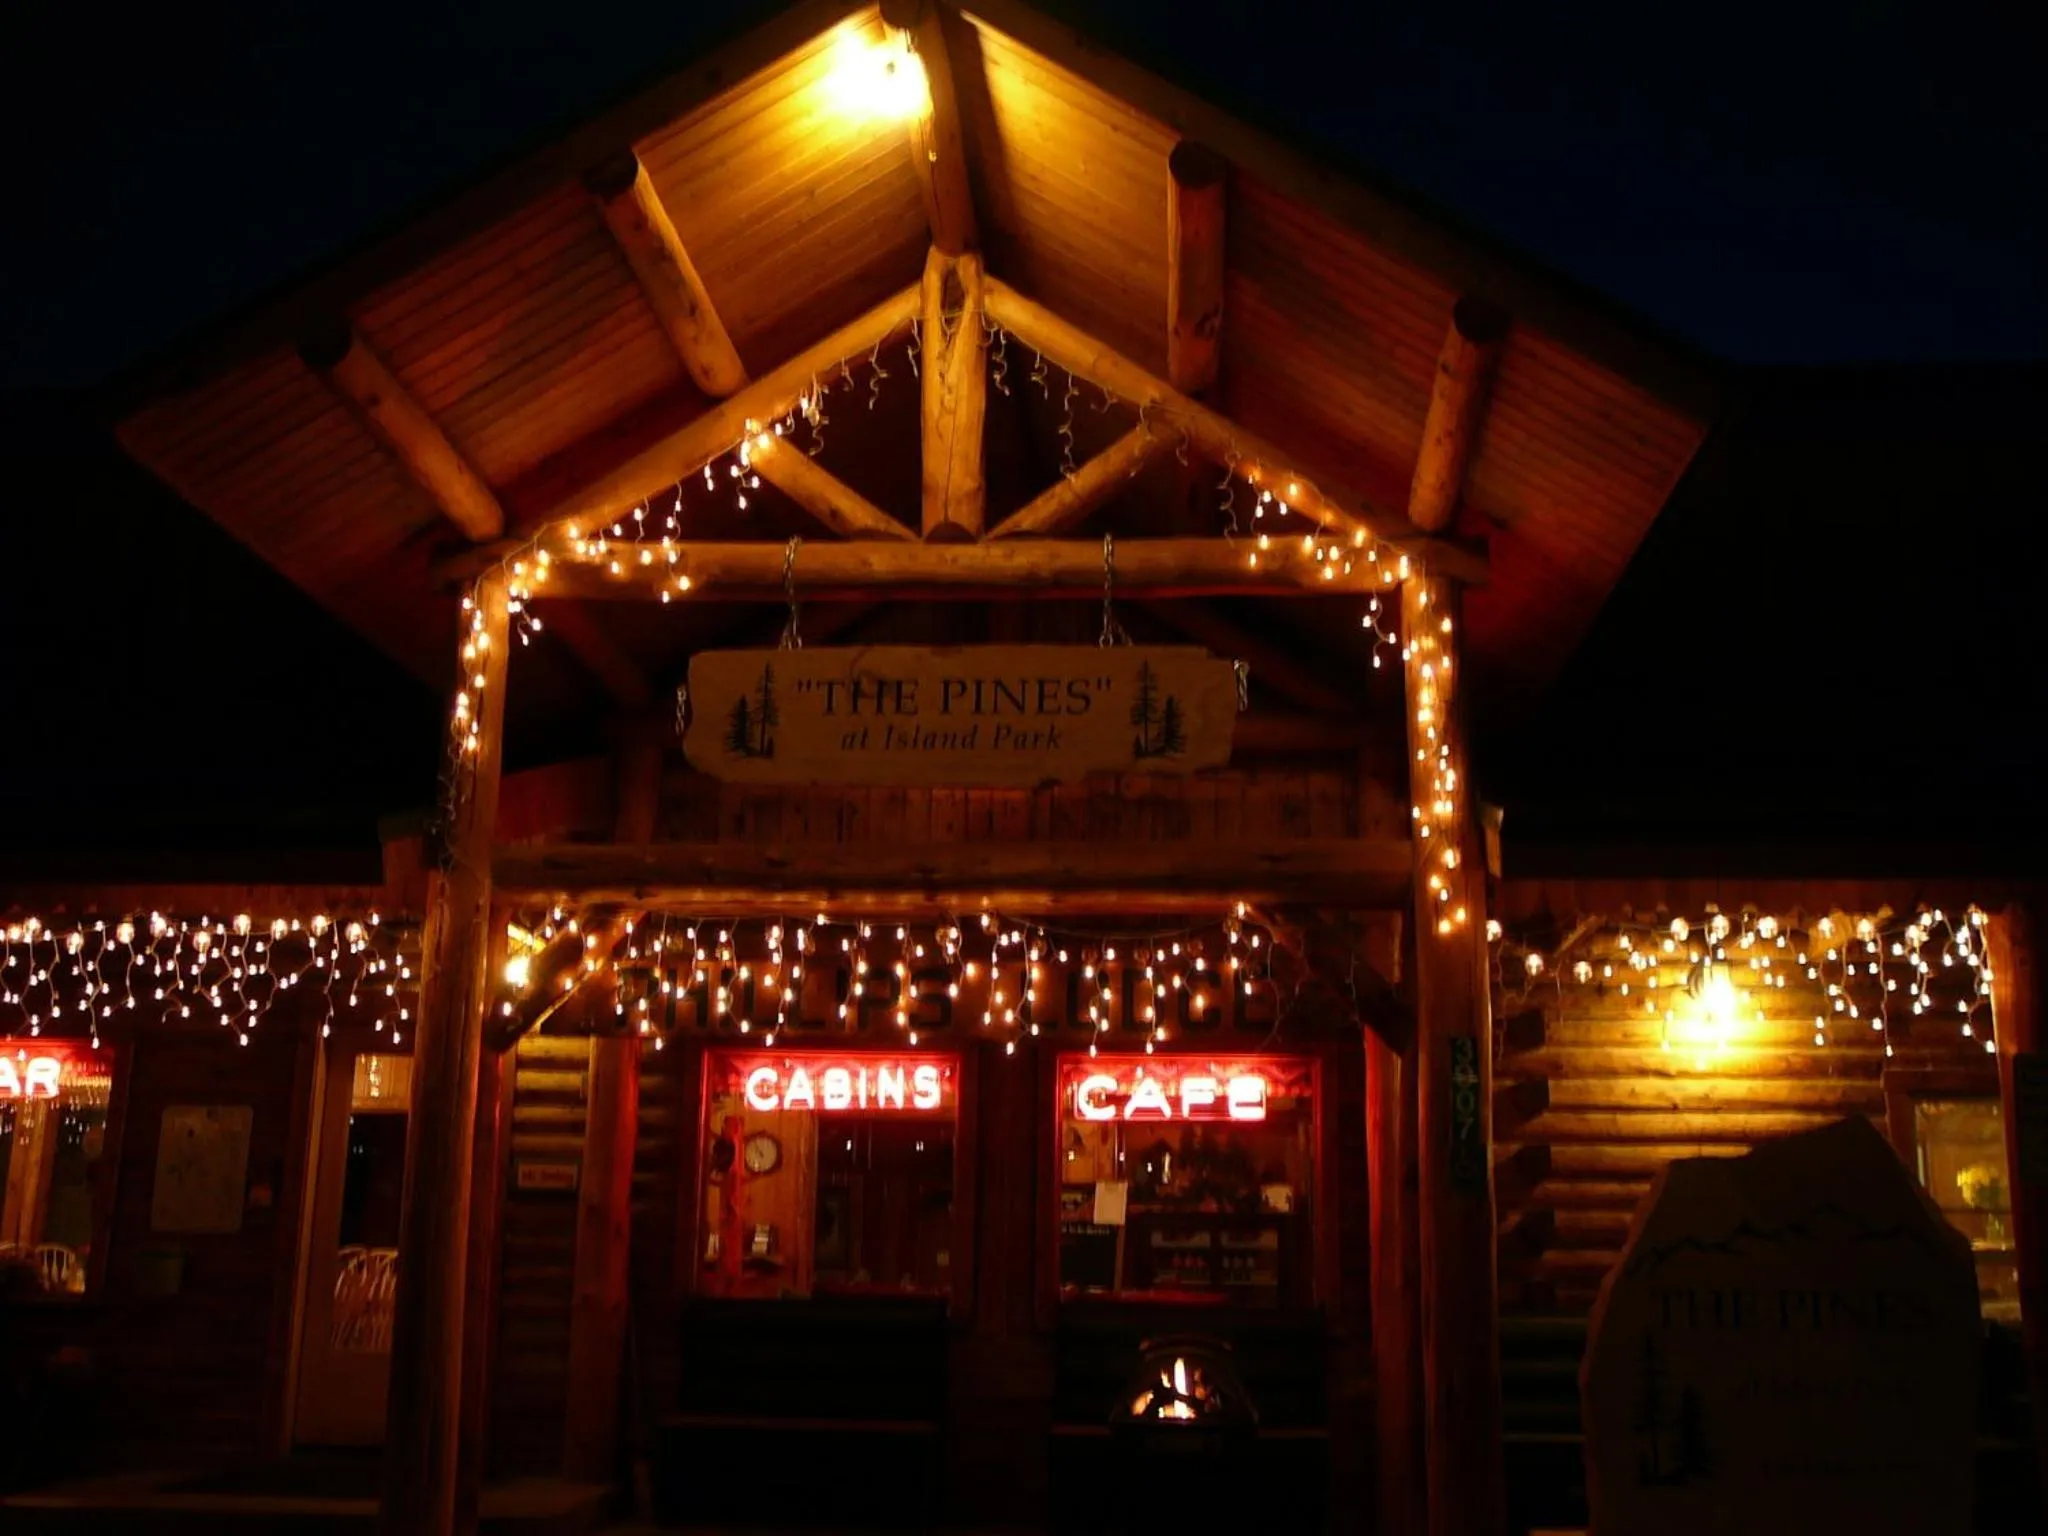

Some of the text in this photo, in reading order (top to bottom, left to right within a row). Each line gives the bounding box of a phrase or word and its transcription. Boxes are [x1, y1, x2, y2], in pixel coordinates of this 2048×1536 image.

[797, 676, 1112, 717] "THE PINES"
[840, 723, 1064, 752] at Island Park
[746, 1065, 941, 1111] CABINS
[1077, 1073, 1266, 1120] CAFE
[1649, 1287, 1933, 1331] THE PINES
